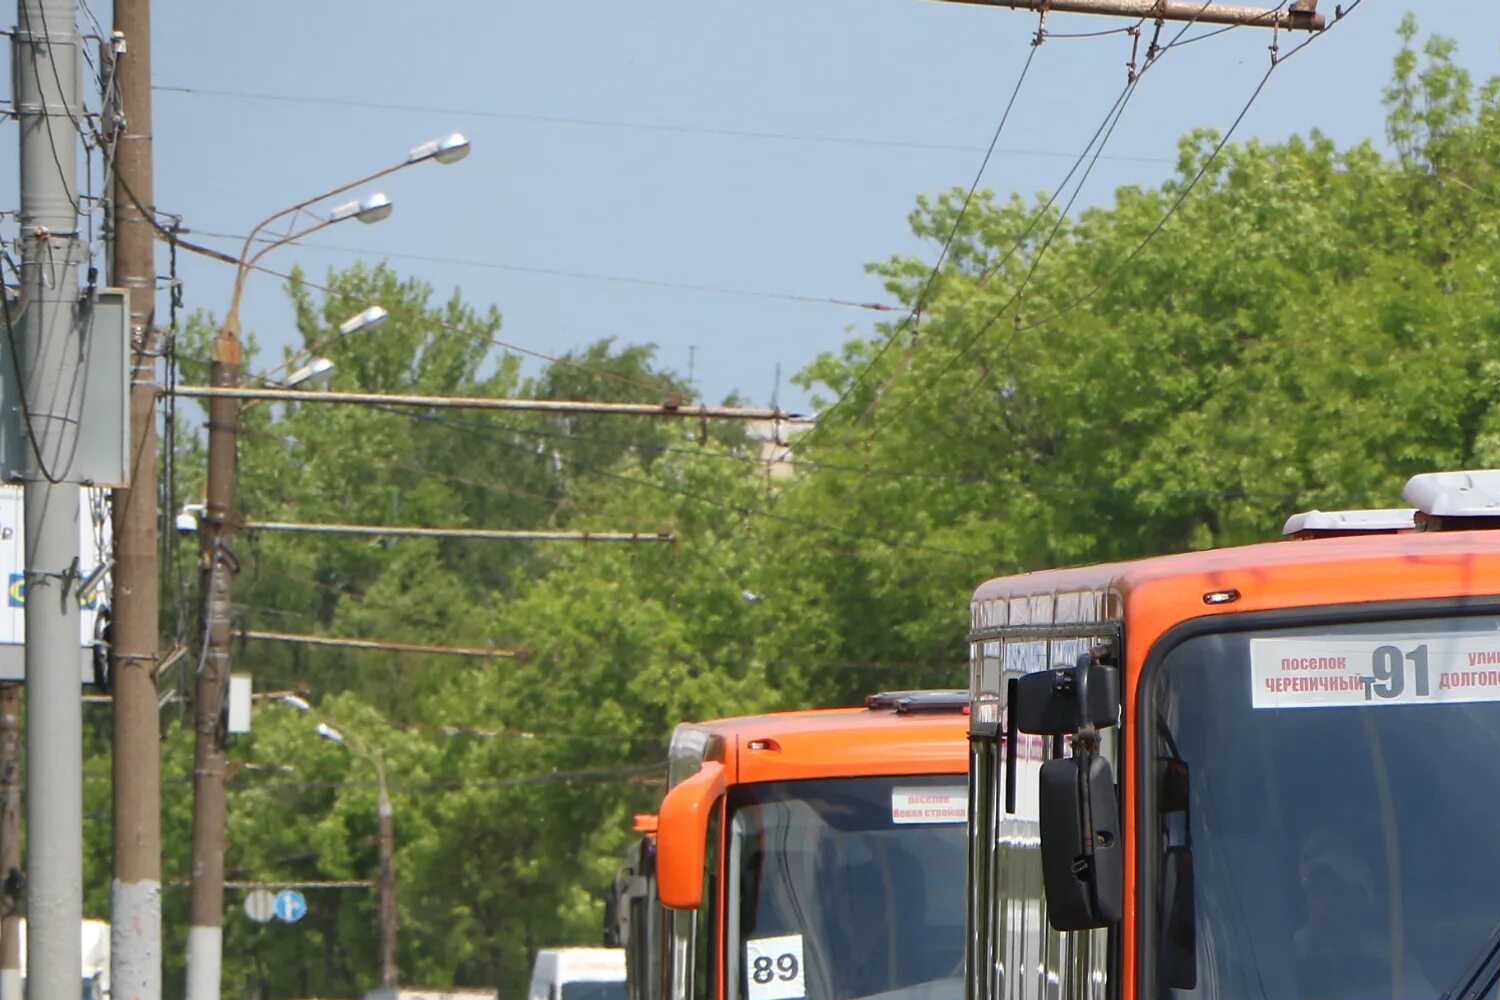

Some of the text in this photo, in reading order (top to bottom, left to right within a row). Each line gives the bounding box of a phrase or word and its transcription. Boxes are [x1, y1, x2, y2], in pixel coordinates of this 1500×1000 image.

[1281, 655, 1347, 671] поселок
[1264, 672, 1363, 693] ЧЕРЕПИЧНЫЙ
[752, 952, 800, 985] 89
